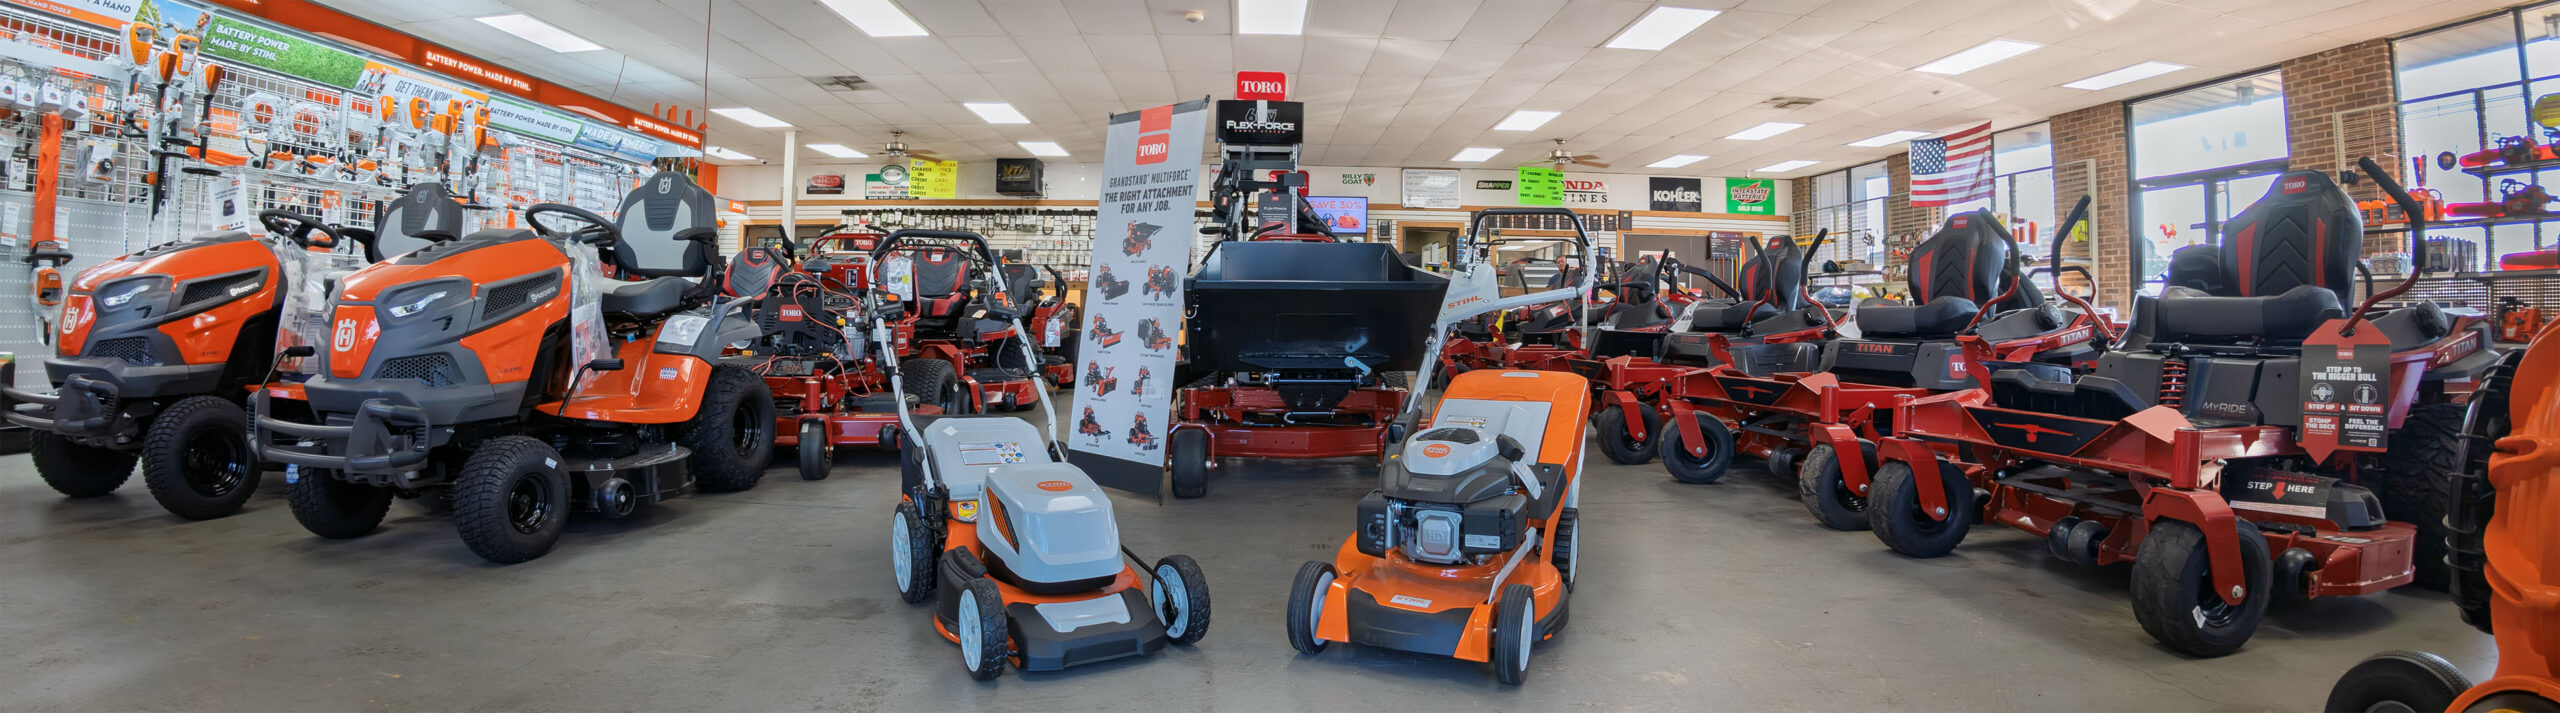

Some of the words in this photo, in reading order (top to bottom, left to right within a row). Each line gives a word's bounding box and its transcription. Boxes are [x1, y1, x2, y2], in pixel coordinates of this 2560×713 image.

[49, 4, 71, 14] TOOLS
[102, 0, 131, 13] HAND
[216, 24, 256, 42] BATTERY
[258, 36, 290, 52] POWER
[210, 37, 238, 50] MADE
[238, 44, 252, 53] BY
[252, 48, 277, 60] STIHL
[427, 52, 458, 68] BATTERY
[458, 62, 484, 76] POWER.
[485, 70, 503, 82] MADE
[504, 76, 512, 85] BY
[513, 79, 532, 92] STIHL.
[395, 80, 412, 94] GET
[411, 84, 433, 100] THEM
[1241, 81, 1282, 94] TORO
[490, 107, 514, 119] BATTERY
[536, 121, 551, 129] MADE
[634, 118, 654, 129] BATTERY
[671, 129, 683, 138] MADE
[1226, 120, 1295, 130] FLEX-FORCE
[582, 125, 609, 140] MADE
[610, 134, 620, 144] IN
[620, 138, 658, 155] AMERICA
[1140, 142, 1166, 156] TORO
[1110, 174, 1148, 188] GRANDSTAND
[1151, 170, 1188, 184] MULTIFORCE
[1563, 181, 1606, 190] NDA
[2284, 181, 2304, 190] TORO
[1105, 192, 1118, 203] THE
[1120, 190, 1141, 202] RIGHT
[1142, 185, 1193, 200] ATTACHMENT
[1654, 190, 1698, 202] KOHLER
[1121, 203, 1136, 214] FOR
[1137, 202, 1152, 212] ANY
[1154, 200, 1170, 212] JOB.
[1310, 201, 1336, 209] SAVE
[1340, 201, 1362, 209] 30%
[1448, 296, 1482, 309] STIHL
[2061, 328, 2089, 344] TITAN
[1857, 343, 1893, 353] TITAN
[2452, 337, 2477, 356] TITAN
[1952, 362, 1966, 372] TO
[2358, 373, 2377, 382] BULL
[2247, 482, 2272, 490] STEP
[2288, 485, 2315, 494] HERE
[1428, 531, 1444, 540] HD
